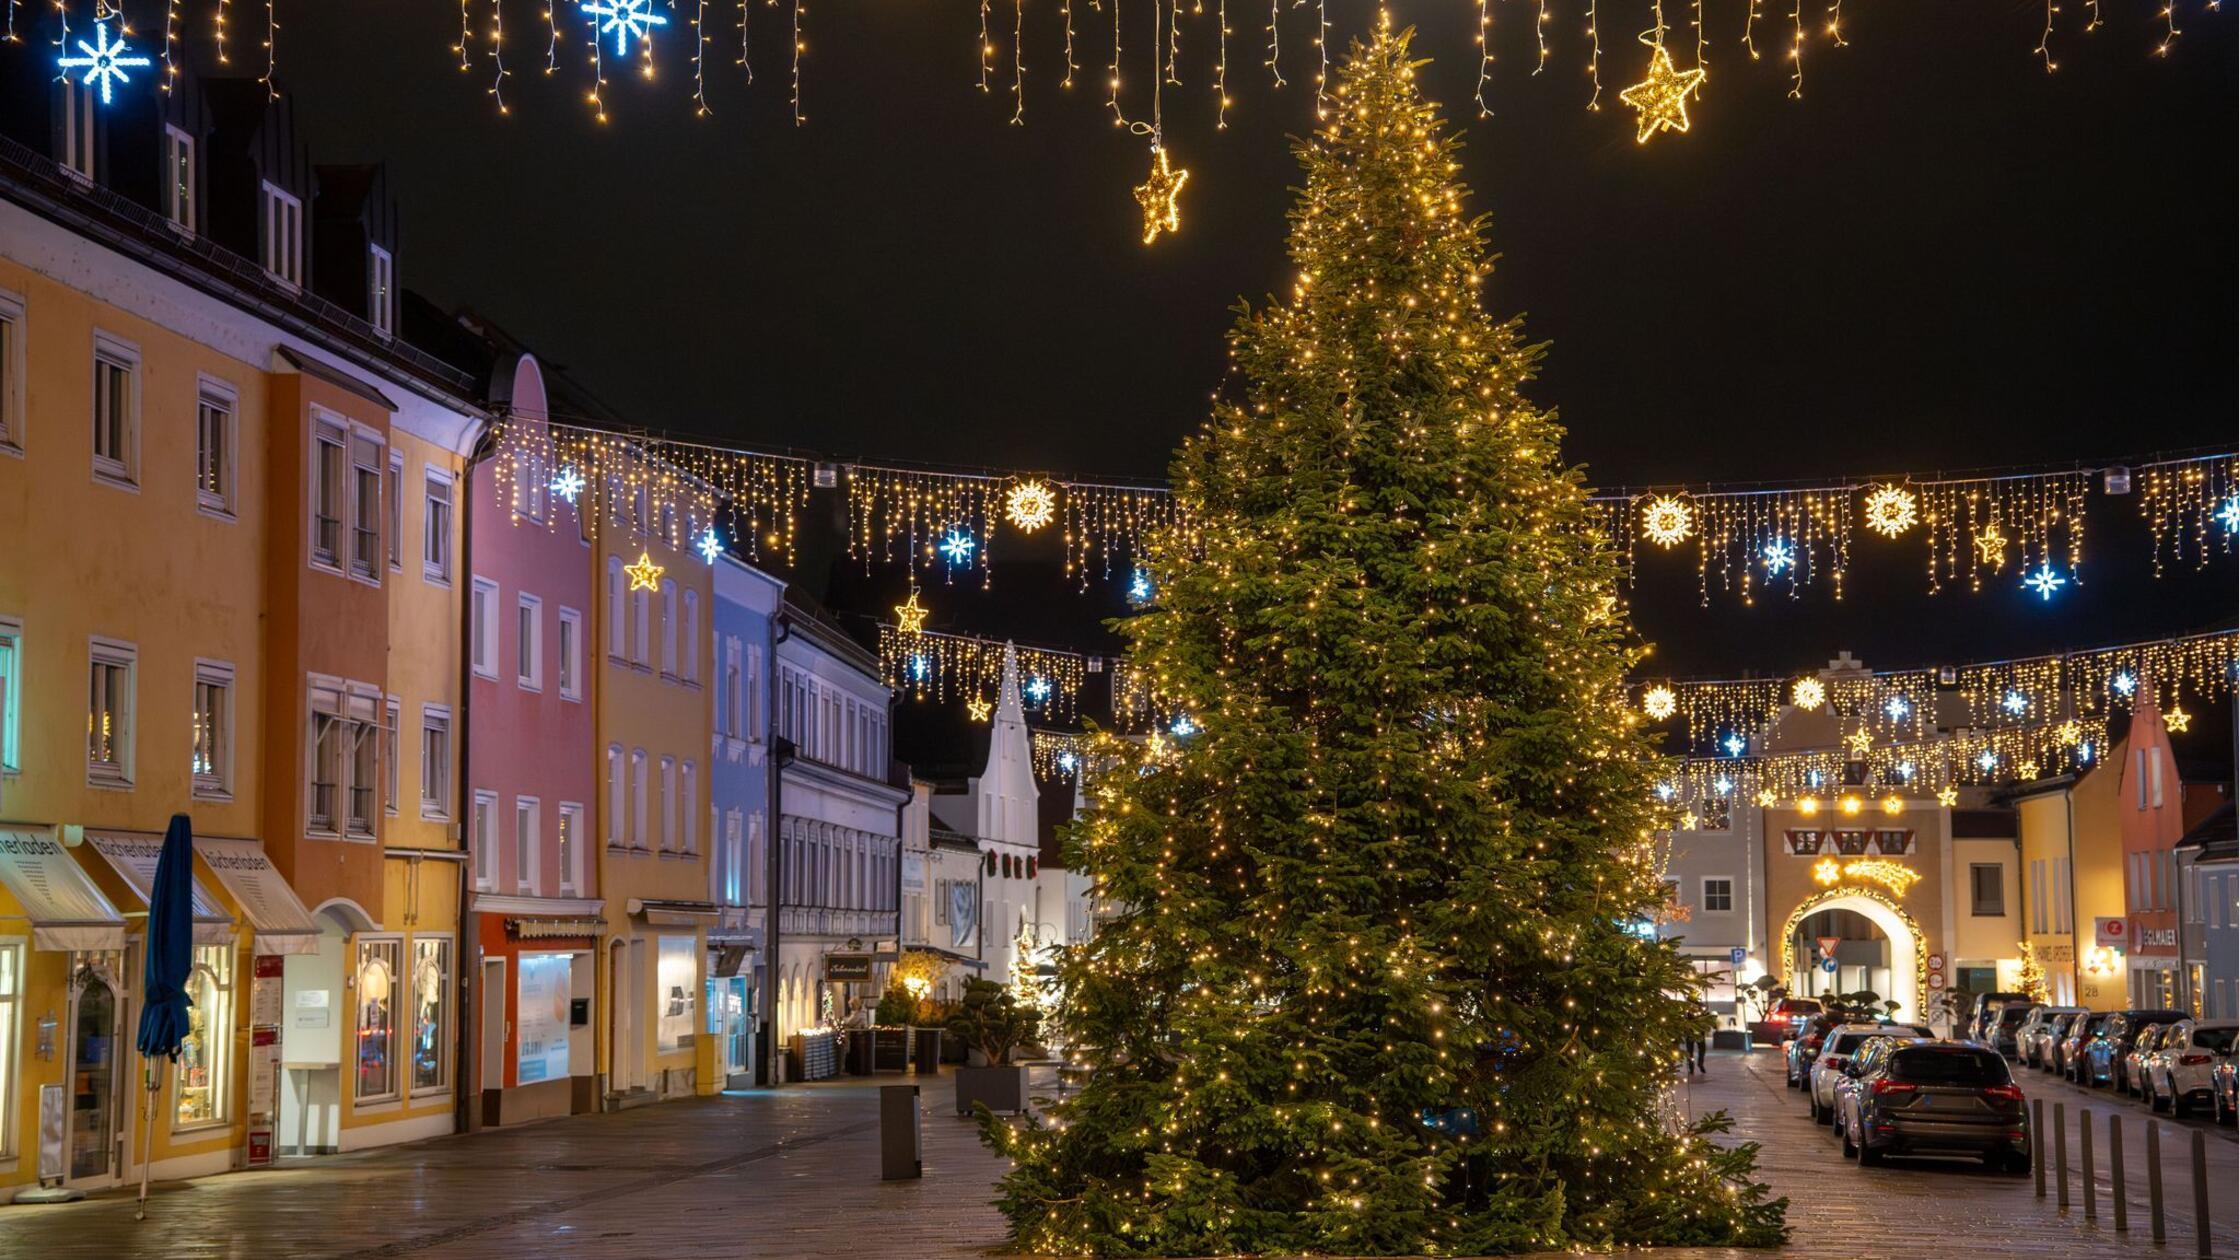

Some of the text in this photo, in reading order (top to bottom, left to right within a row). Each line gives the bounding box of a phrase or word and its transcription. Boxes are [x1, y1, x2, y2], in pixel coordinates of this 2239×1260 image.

[91, 836, 161, 858] bücherlade
[200, 847, 272, 871] bücherladen
[1734, 950, 1744, 963] P
[2085, 986, 2098, 998] 28
